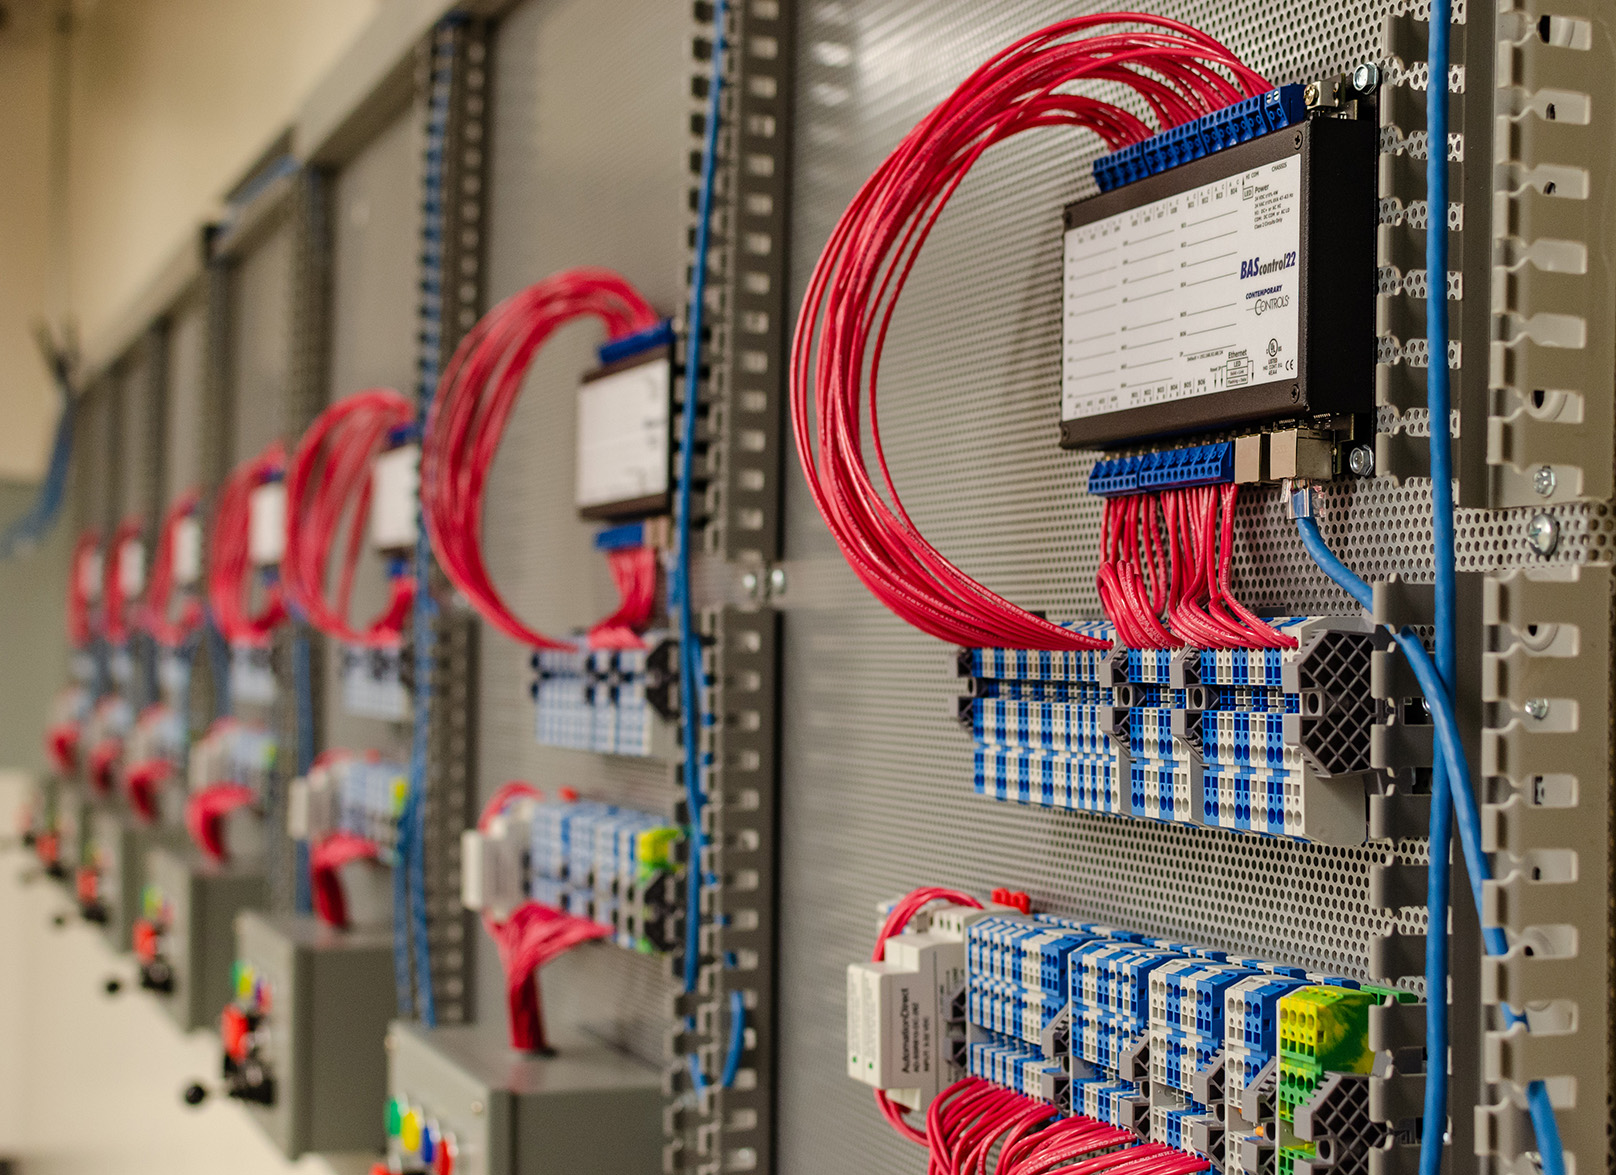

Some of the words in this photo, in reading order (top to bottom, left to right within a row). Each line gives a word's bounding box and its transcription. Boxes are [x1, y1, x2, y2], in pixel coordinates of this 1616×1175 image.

[1271, 162, 1287, 172] CHASSIS
[1255, 184, 1269, 193] Power
[1240, 251, 1296, 280] BAScontrol22
[1246, 284, 1283, 299] CONTEMPORARY
[1255, 294, 1289, 316] CONTROLS
[1228, 349, 1247, 359] Ethernet
[1285, 359, 1294, 371] CE
[901, 987, 910, 1073] AutomationDirect
